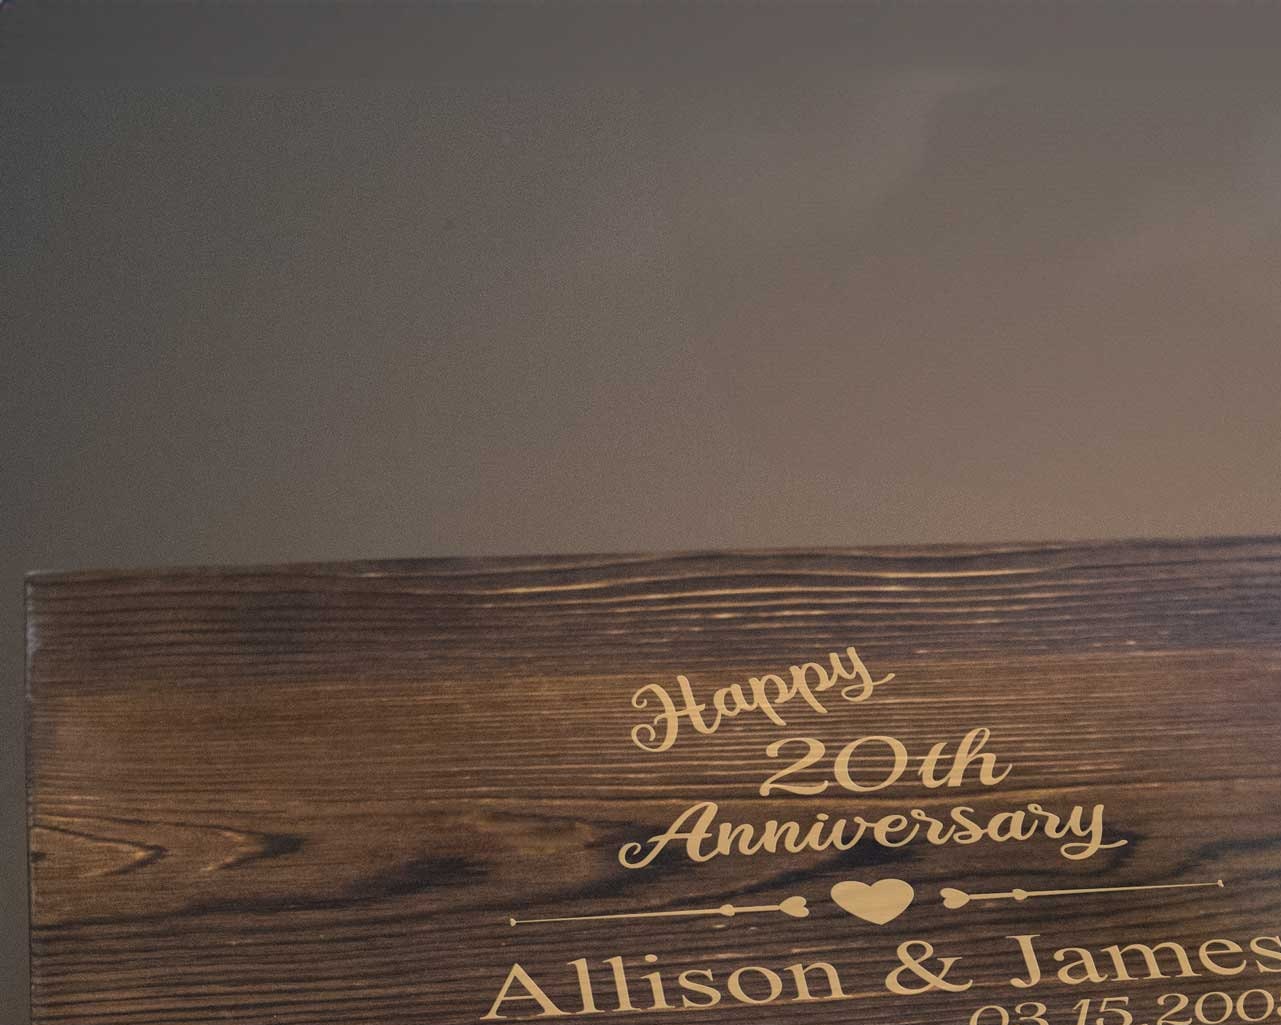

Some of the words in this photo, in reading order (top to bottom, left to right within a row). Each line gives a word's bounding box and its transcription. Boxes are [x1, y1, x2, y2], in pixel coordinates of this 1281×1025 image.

[630, 646, 895, 753] Happy
[759, 726, 1014, 797] 20th
[617, 800, 1128, 870] Anniversary
[480, 953, 844, 1021] Allison
[885, 939, 973, 996] &
